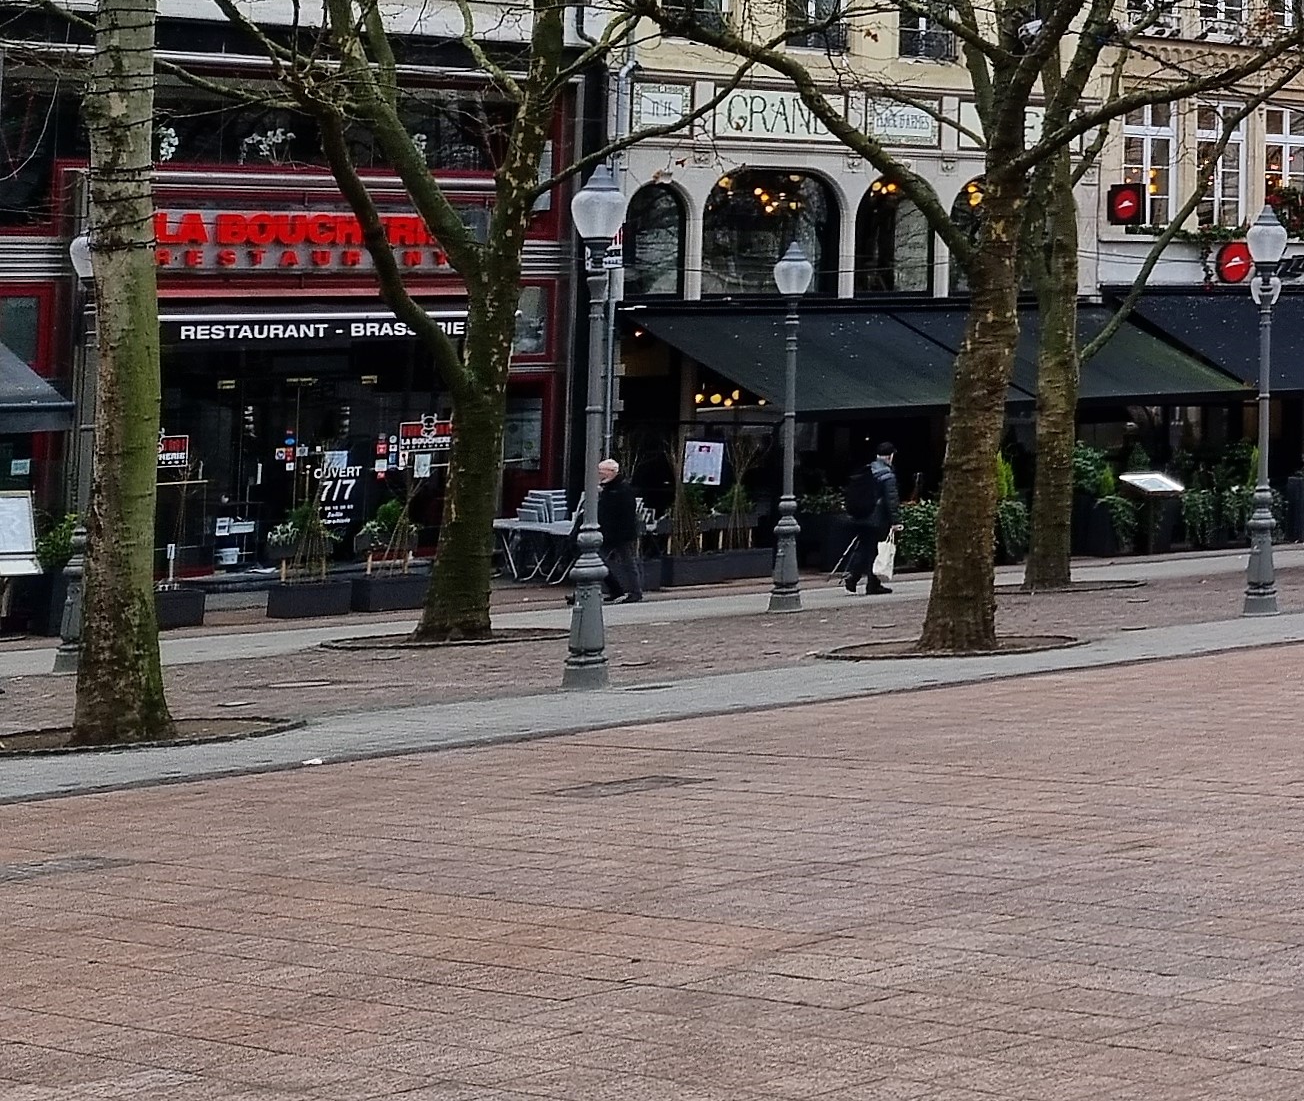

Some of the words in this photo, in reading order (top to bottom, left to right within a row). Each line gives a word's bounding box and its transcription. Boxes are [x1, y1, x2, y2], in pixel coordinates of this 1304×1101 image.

[154, 212, 208, 244] LA
[216, 213, 440, 245] BOUCHRI
[156, 250, 449, 267] RESTAURN
[180, 323, 329, 340] RESTAURANT
[350, 322, 464, 338] BRASRIE
[313, 466, 363, 480] OUVERT
[320, 479, 356, 501] 7/7
